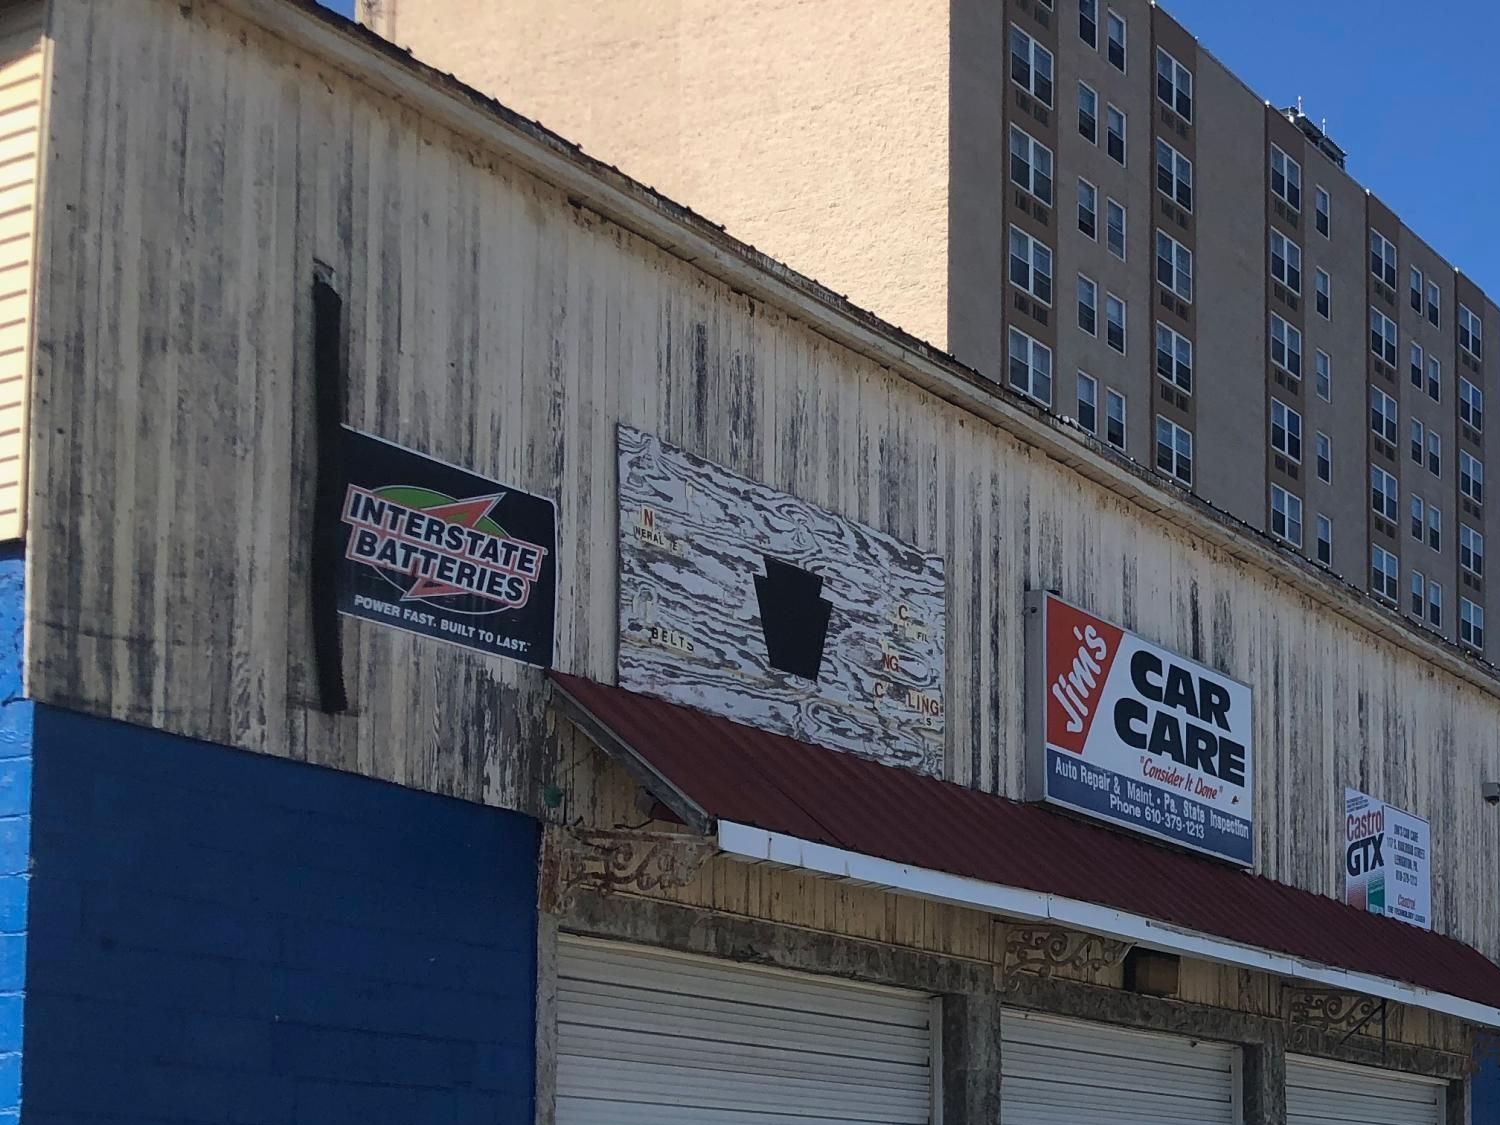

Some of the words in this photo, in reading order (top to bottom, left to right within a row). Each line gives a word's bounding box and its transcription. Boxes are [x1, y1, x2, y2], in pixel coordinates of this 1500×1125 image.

[350, 493, 538, 573] INTERSTATE
[354, 529, 526, 602] BATTERIES
[354, 595, 401, 618] POWER
[403, 608, 437, 628] FAST.
[440, 618, 476, 638] BUILT
[478, 629, 494, 644] TO
[496, 634, 529, 653] LAST.
[1130, 650, 1233, 733] CAR
[1113, 697, 1246, 788] CARE
[1055, 756, 1078, 781] Auto
[1080, 764, 1111, 792] Repair
[1113, 775, 1121, 795] &
[1183, 799, 1206, 823] State
[1209, 808, 1250, 840] Inspection
[1186, 772, 1194, 793] It
[1109, 792, 1142, 819] Phone
[1144, 805, 1206, 840] 610-379-1213
[1346, 805, 1385, 842] Castrol
[1346, 832, 1385, 877] GTX
